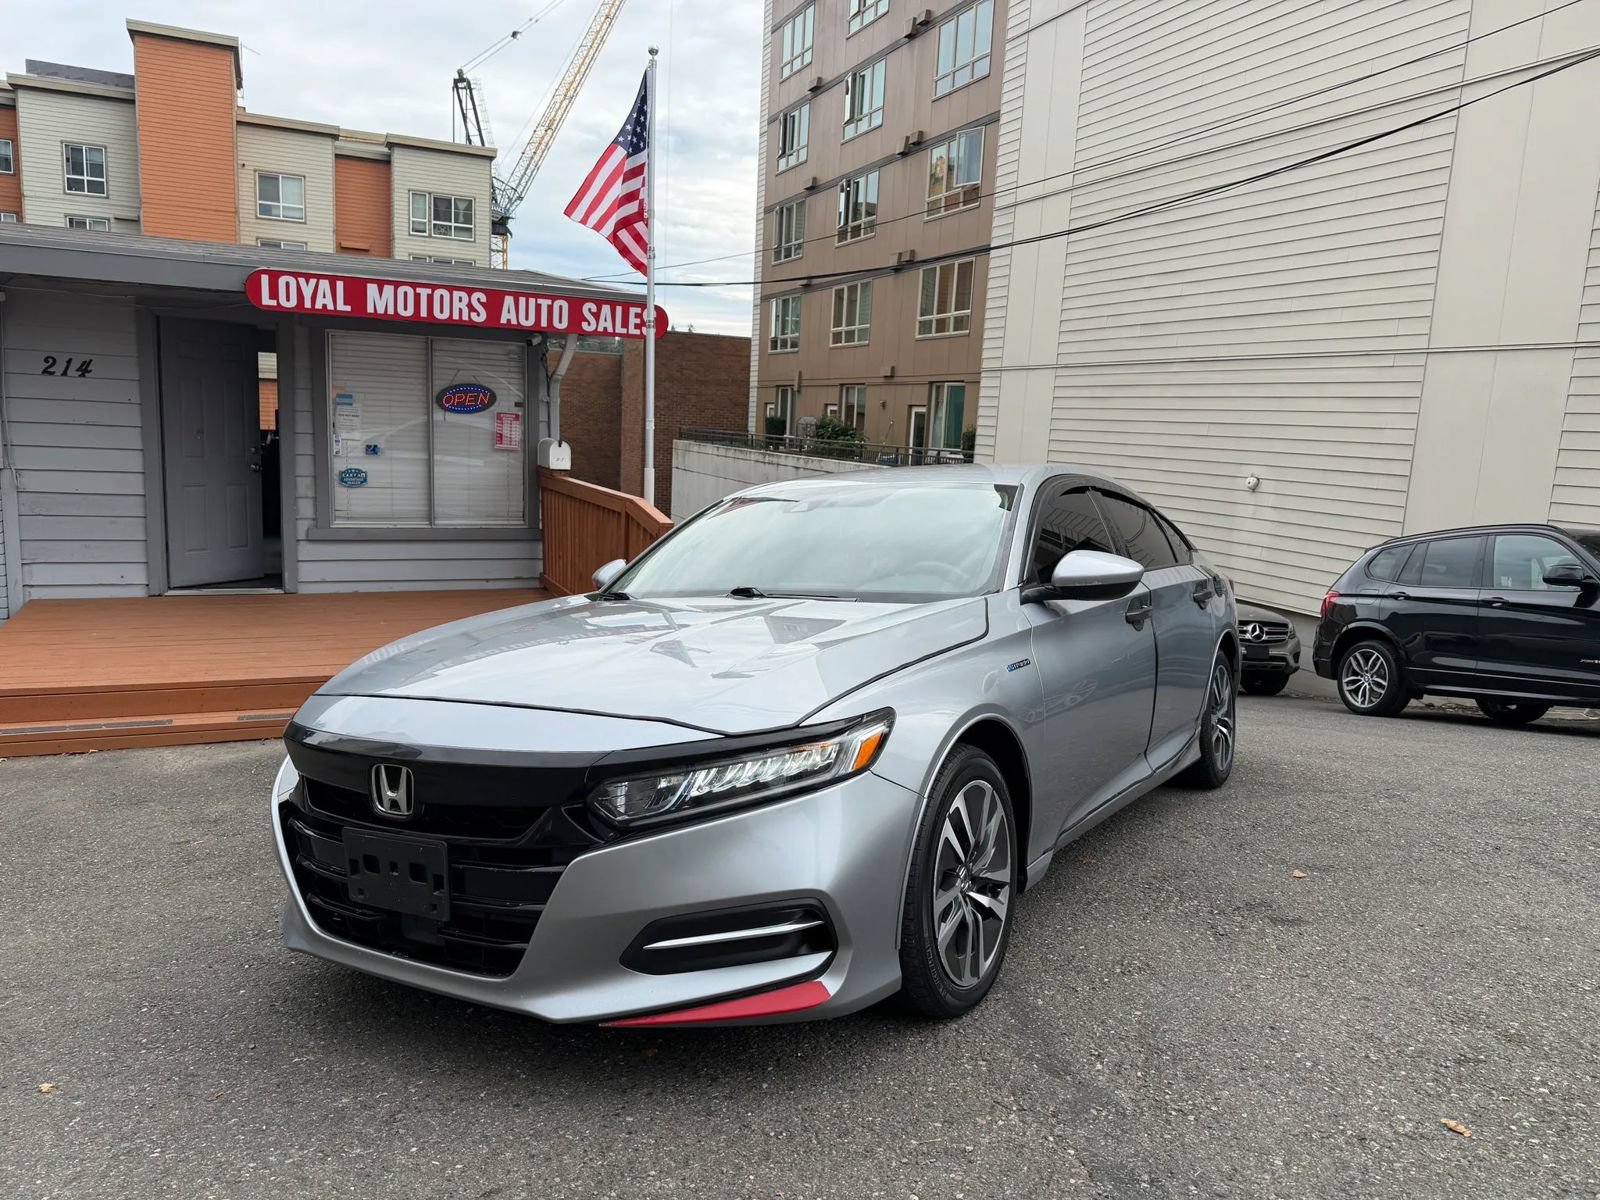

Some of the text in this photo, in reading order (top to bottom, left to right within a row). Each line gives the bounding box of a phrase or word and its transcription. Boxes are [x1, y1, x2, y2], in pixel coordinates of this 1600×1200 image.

[260, 274, 351, 312] LOYAL
[366, 283, 487, 323] MOTORS
[500, 296, 569, 329] AUTO
[41, 355, 93, 377] 214
[442, 391, 490, 407] OPEN
